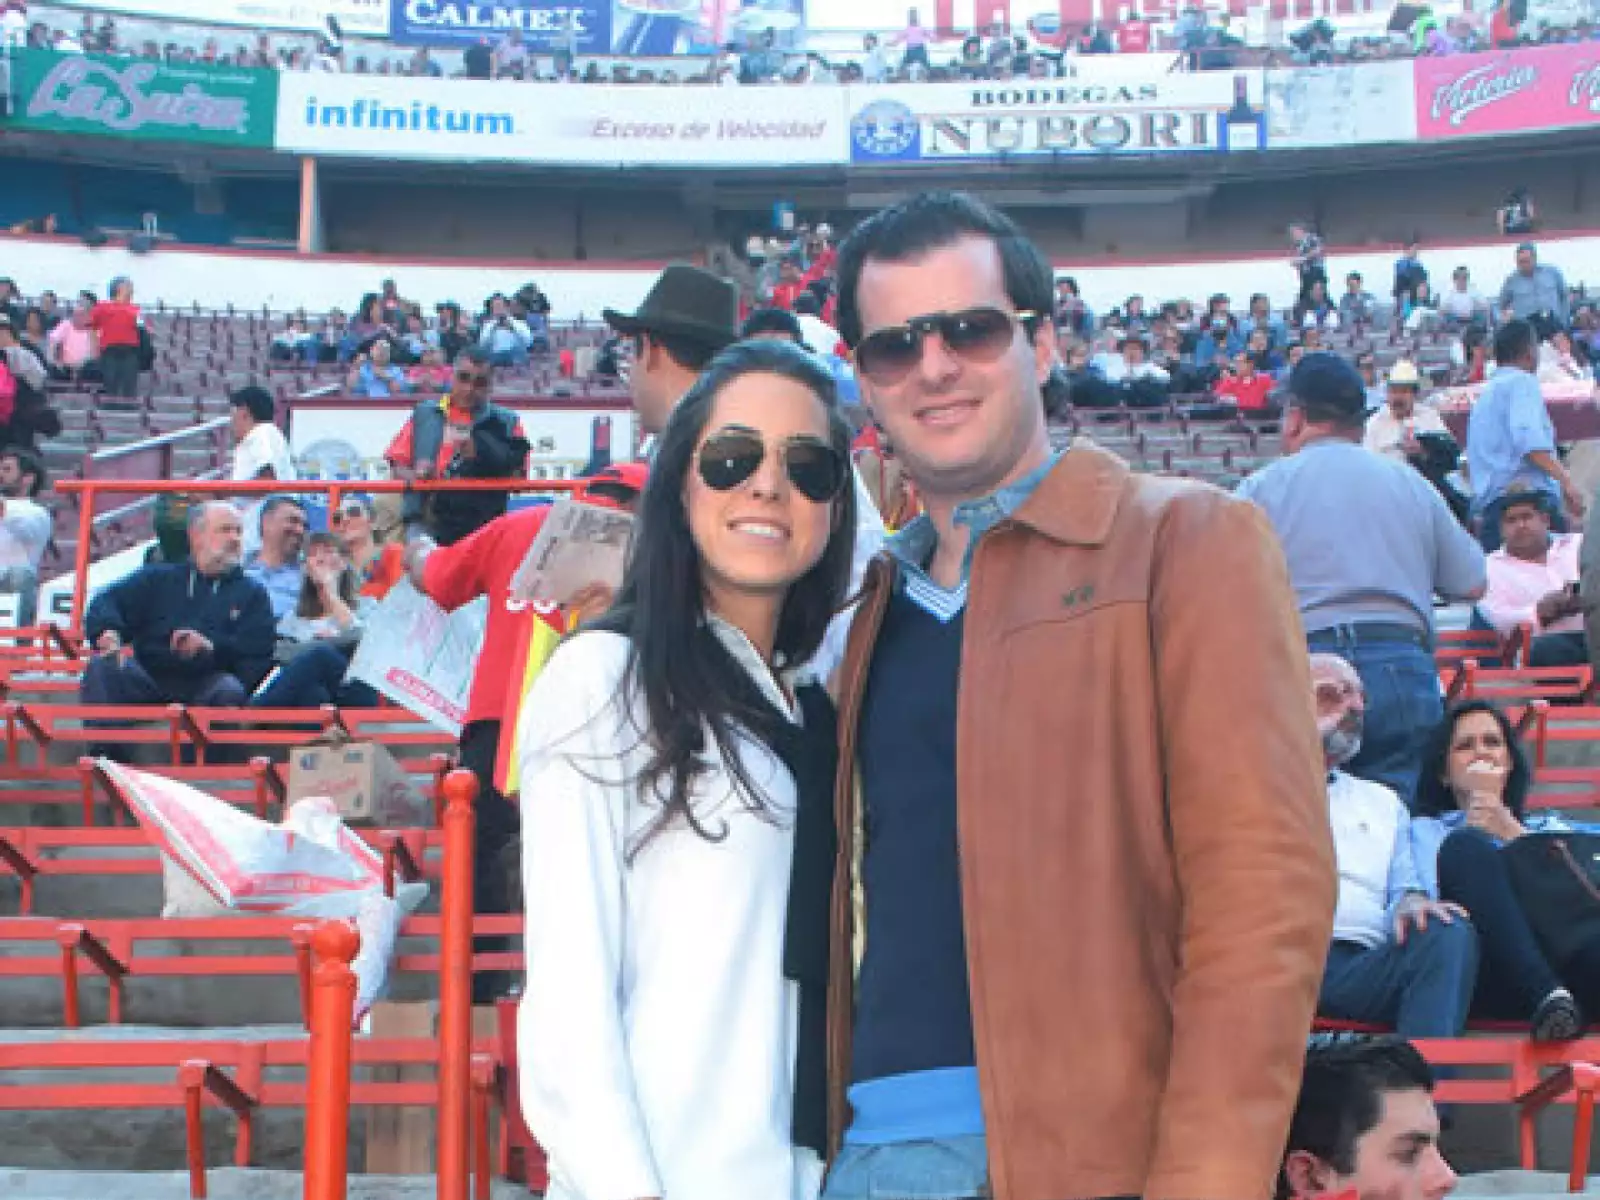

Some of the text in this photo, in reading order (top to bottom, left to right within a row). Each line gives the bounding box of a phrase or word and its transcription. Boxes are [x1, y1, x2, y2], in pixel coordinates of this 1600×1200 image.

[404, 0, 586, 31] CALMEX
[970, 83, 1158, 107] BODEGAS
[305, 95, 516, 135] infinitum
[590, 116, 674, 140] Exceso
[680, 117, 710, 140] de
[716, 116, 828, 141] Velocidad
[928, 110, 1216, 152] NUBORI
